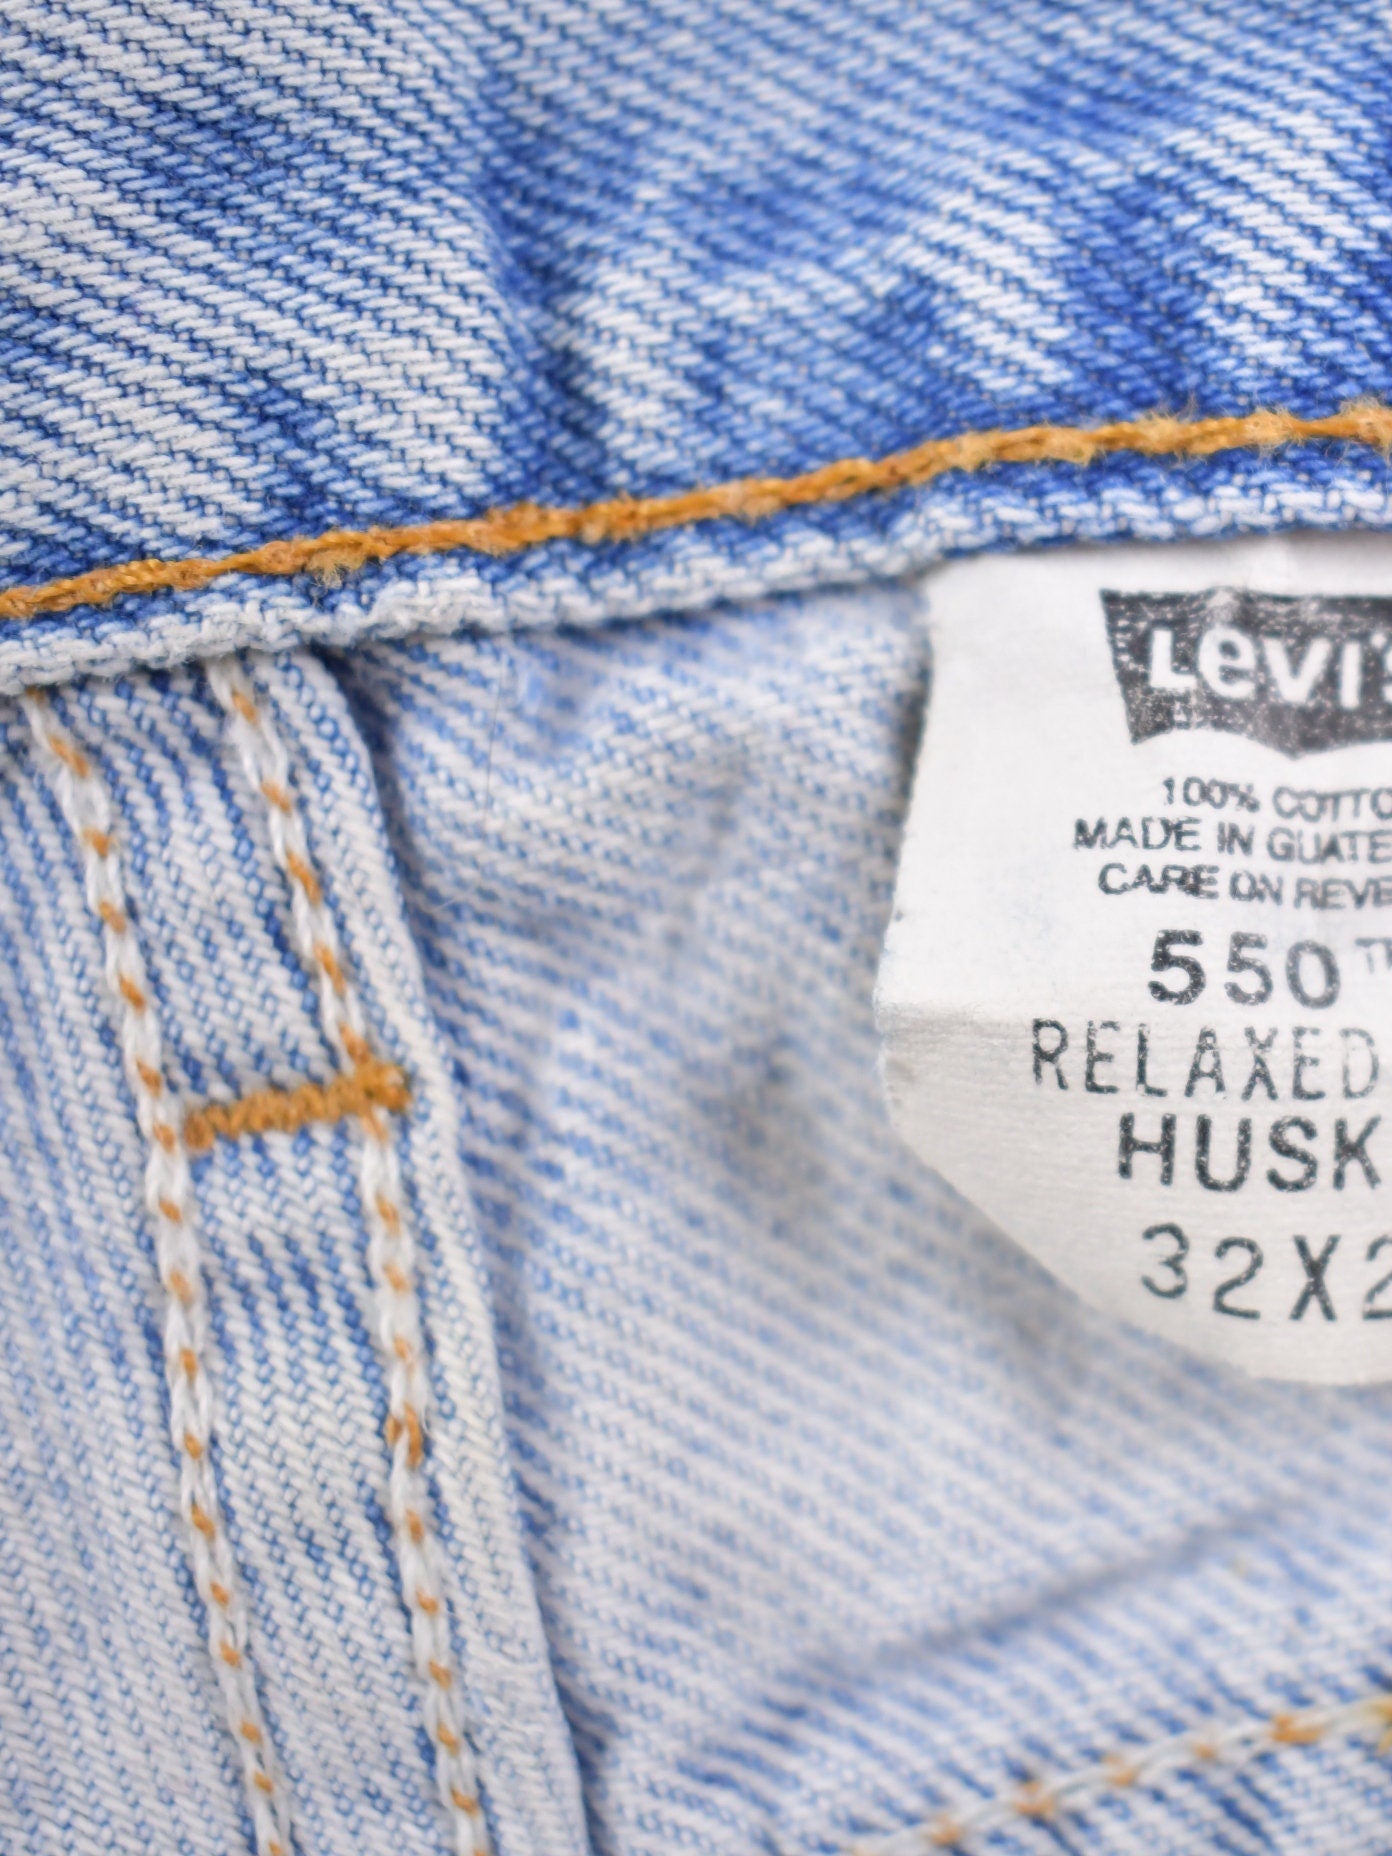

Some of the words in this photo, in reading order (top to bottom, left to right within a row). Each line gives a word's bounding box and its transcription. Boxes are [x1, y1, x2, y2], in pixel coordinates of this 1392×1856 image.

[1161, 777, 1260, 813] 100%
[1072, 818, 1201, 850] MADE
[1216, 826, 1254, 858] IN
[1098, 863, 1218, 901] CARE
[1229, 871, 1283, 906] ON
[1030, 1017, 1381, 1102] RELAXED
